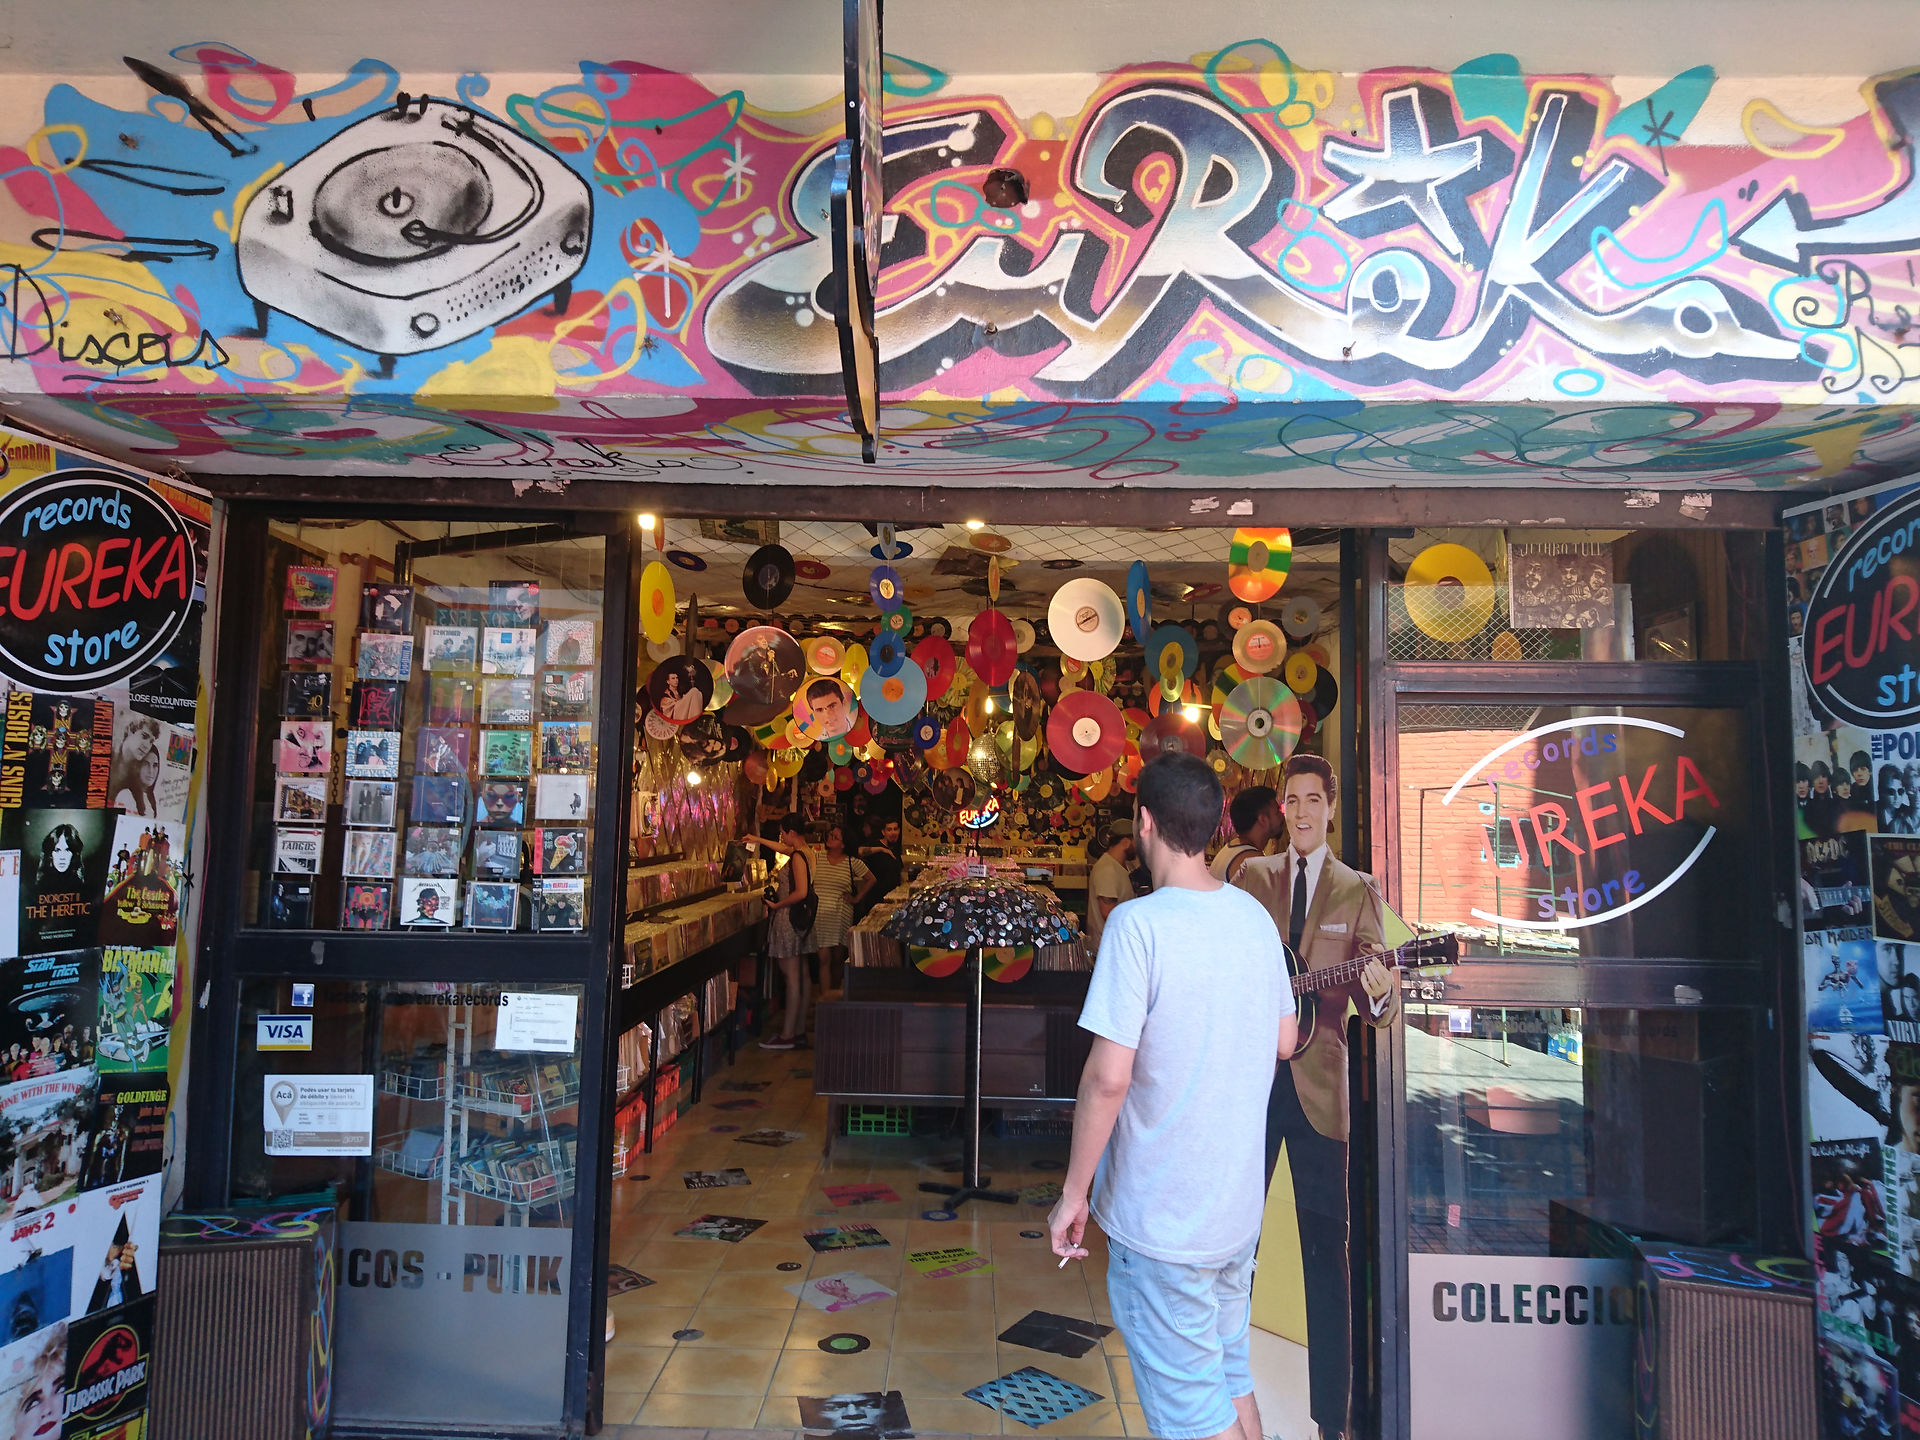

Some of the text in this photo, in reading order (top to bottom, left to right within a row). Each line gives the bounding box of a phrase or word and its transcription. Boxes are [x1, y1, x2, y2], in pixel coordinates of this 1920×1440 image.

[22, 490, 131, 537] records
[44, 620, 140, 667] store
[1813, 575, 1920, 685] EUR
[5, 691, 33, 743] ROSES
[129, 692, 150, 703] CLOSE
[151, 697, 197, 708] ENCOUNTERS
[1485, 727, 1618, 793] records
[1871, 734, 1883, 761] THE
[0, 765, 25, 808] GUNS
[25, 902, 91, 919] THE HERETIC
[1537, 869, 1646, 918] store
[102, 949, 160, 973] BATMAN
[264, 1024, 304, 1039] VISA
[21, 1087, 43, 1100] WITH
[44, 1083, 60, 1096] THE
[276, 1090, 292, 1099] Acá
[10, 1221, 42, 1243] JAWS
[43, 1211, 55, 1231] 2
[463, 1253, 563, 1296] PUNK
[1819, 1309, 1898, 1356] PRESLEY
[62, 1376, 115, 1420] JURASSIC
[115, 1361, 146, 1394] PARK
